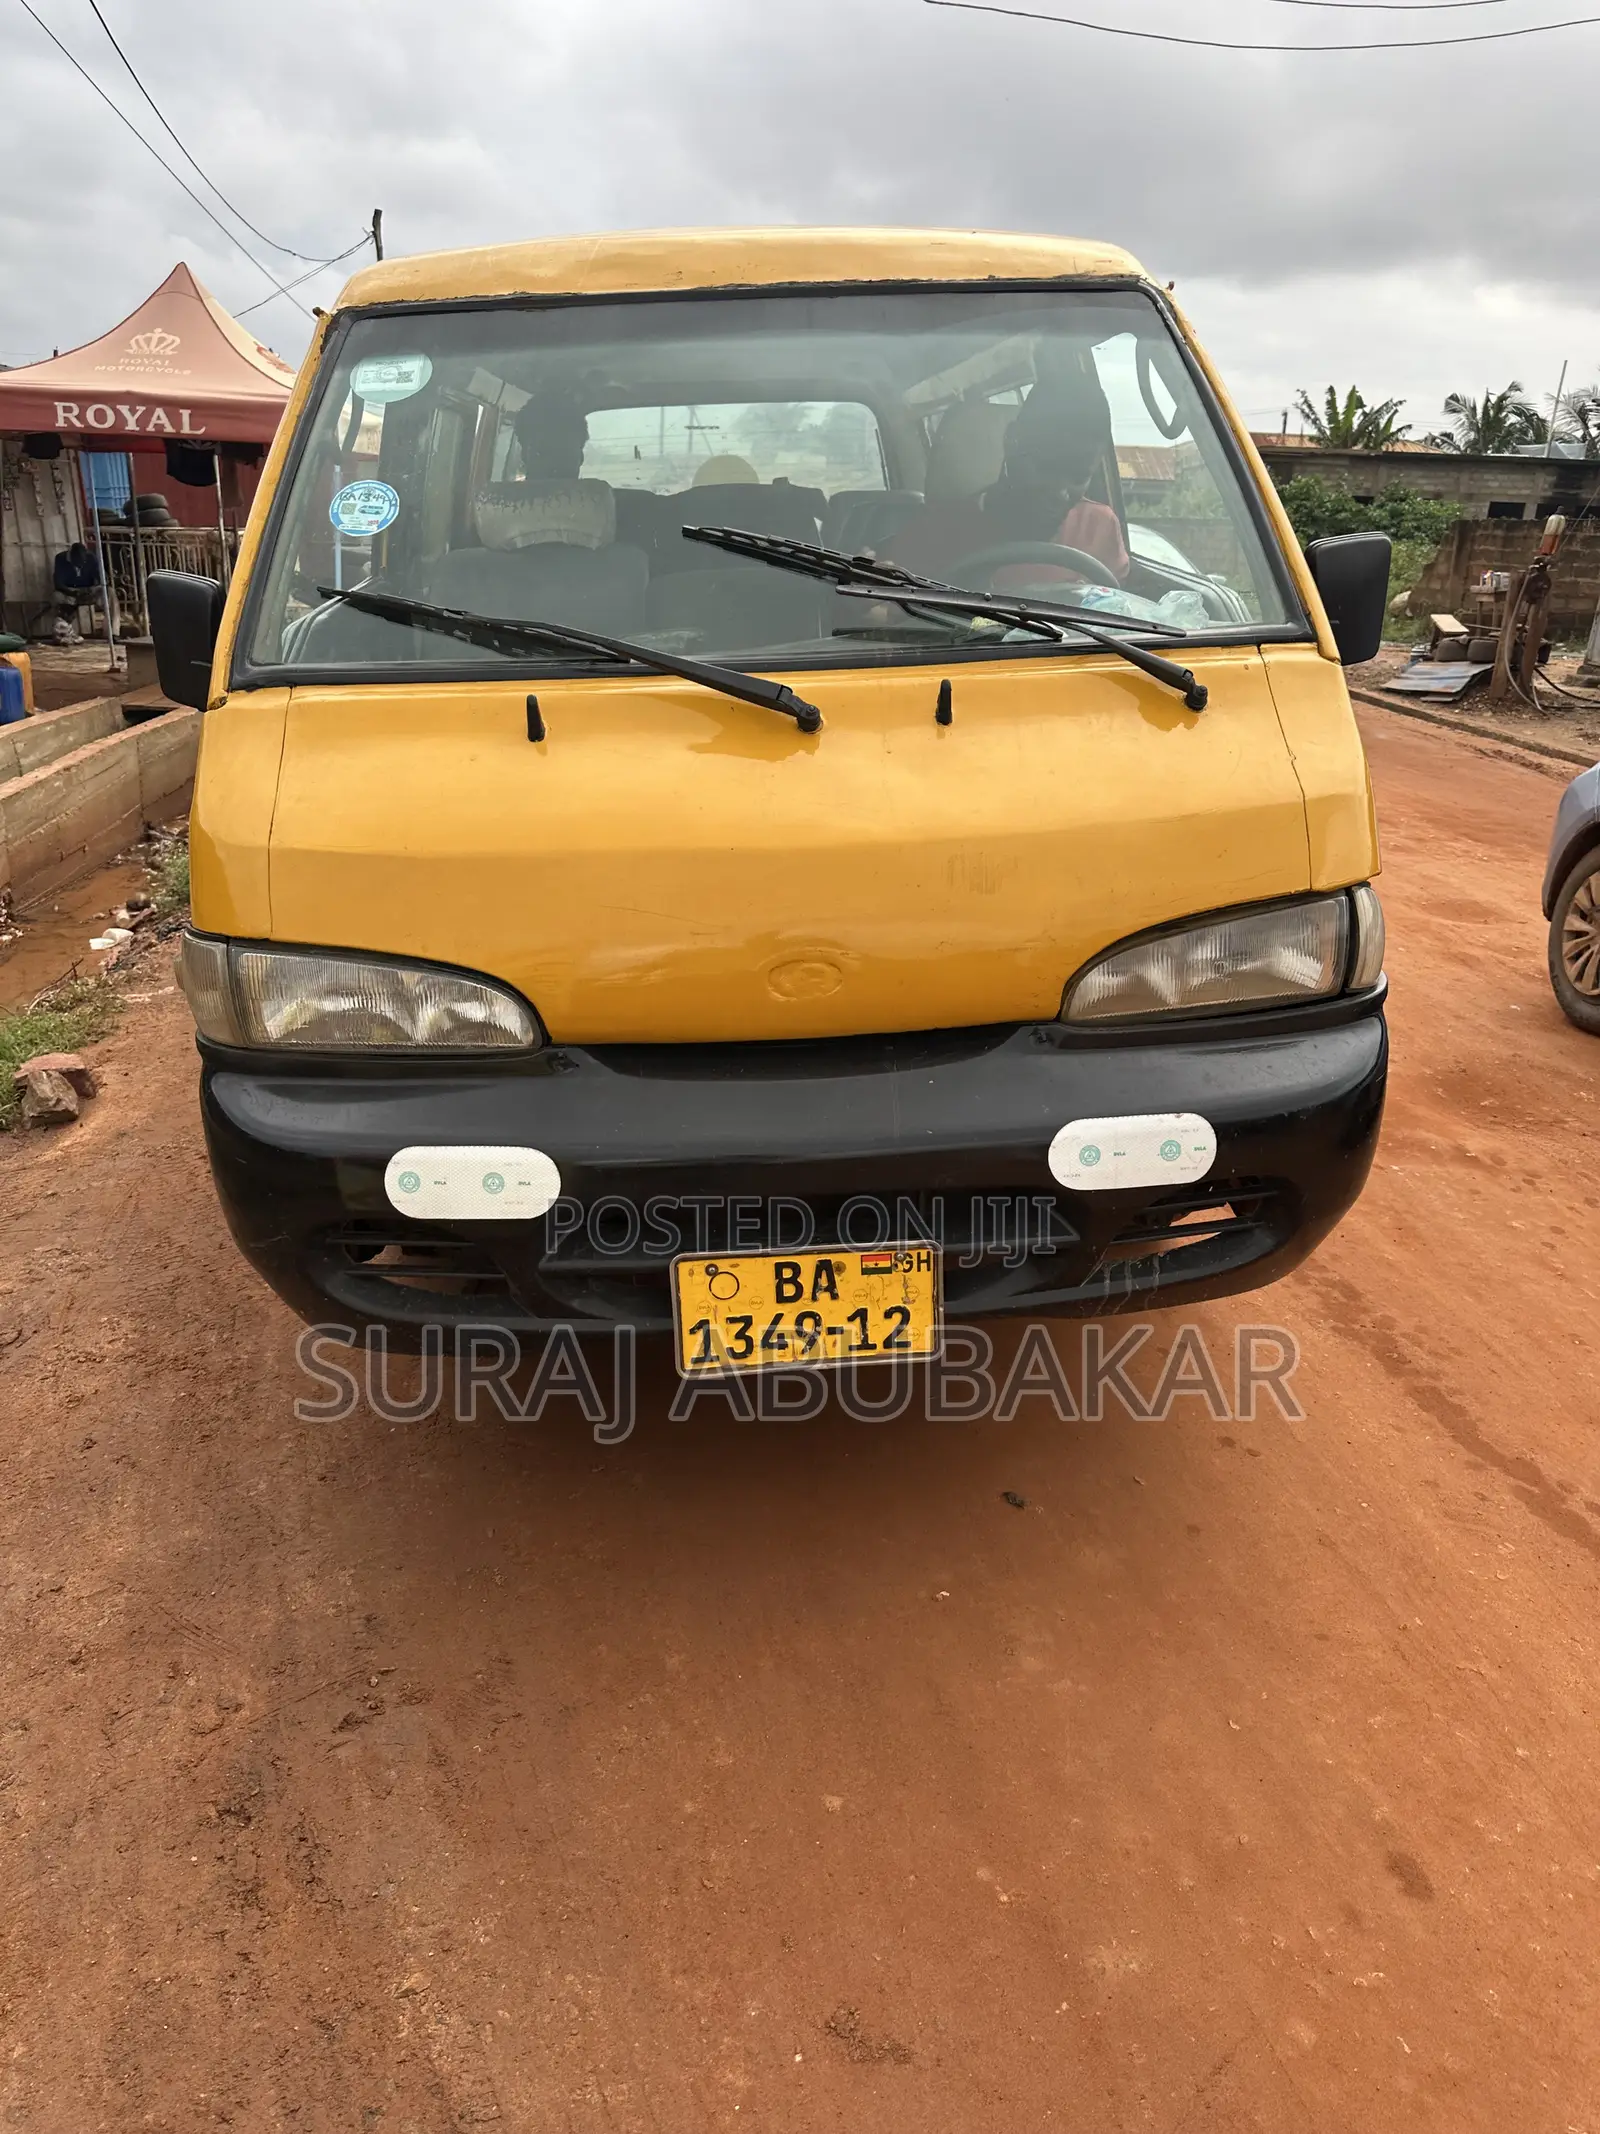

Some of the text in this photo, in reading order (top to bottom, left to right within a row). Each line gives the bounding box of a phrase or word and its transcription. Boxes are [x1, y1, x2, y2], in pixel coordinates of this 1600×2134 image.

[94, 365, 192, 375] MOTORCYCLE
[119, 358, 171, 366] ROYAL
[53, 402, 206, 435] ROYAL
[774, 1250, 932, 1304] BA GH
[689, 1305, 912, 1364] 1349-12
